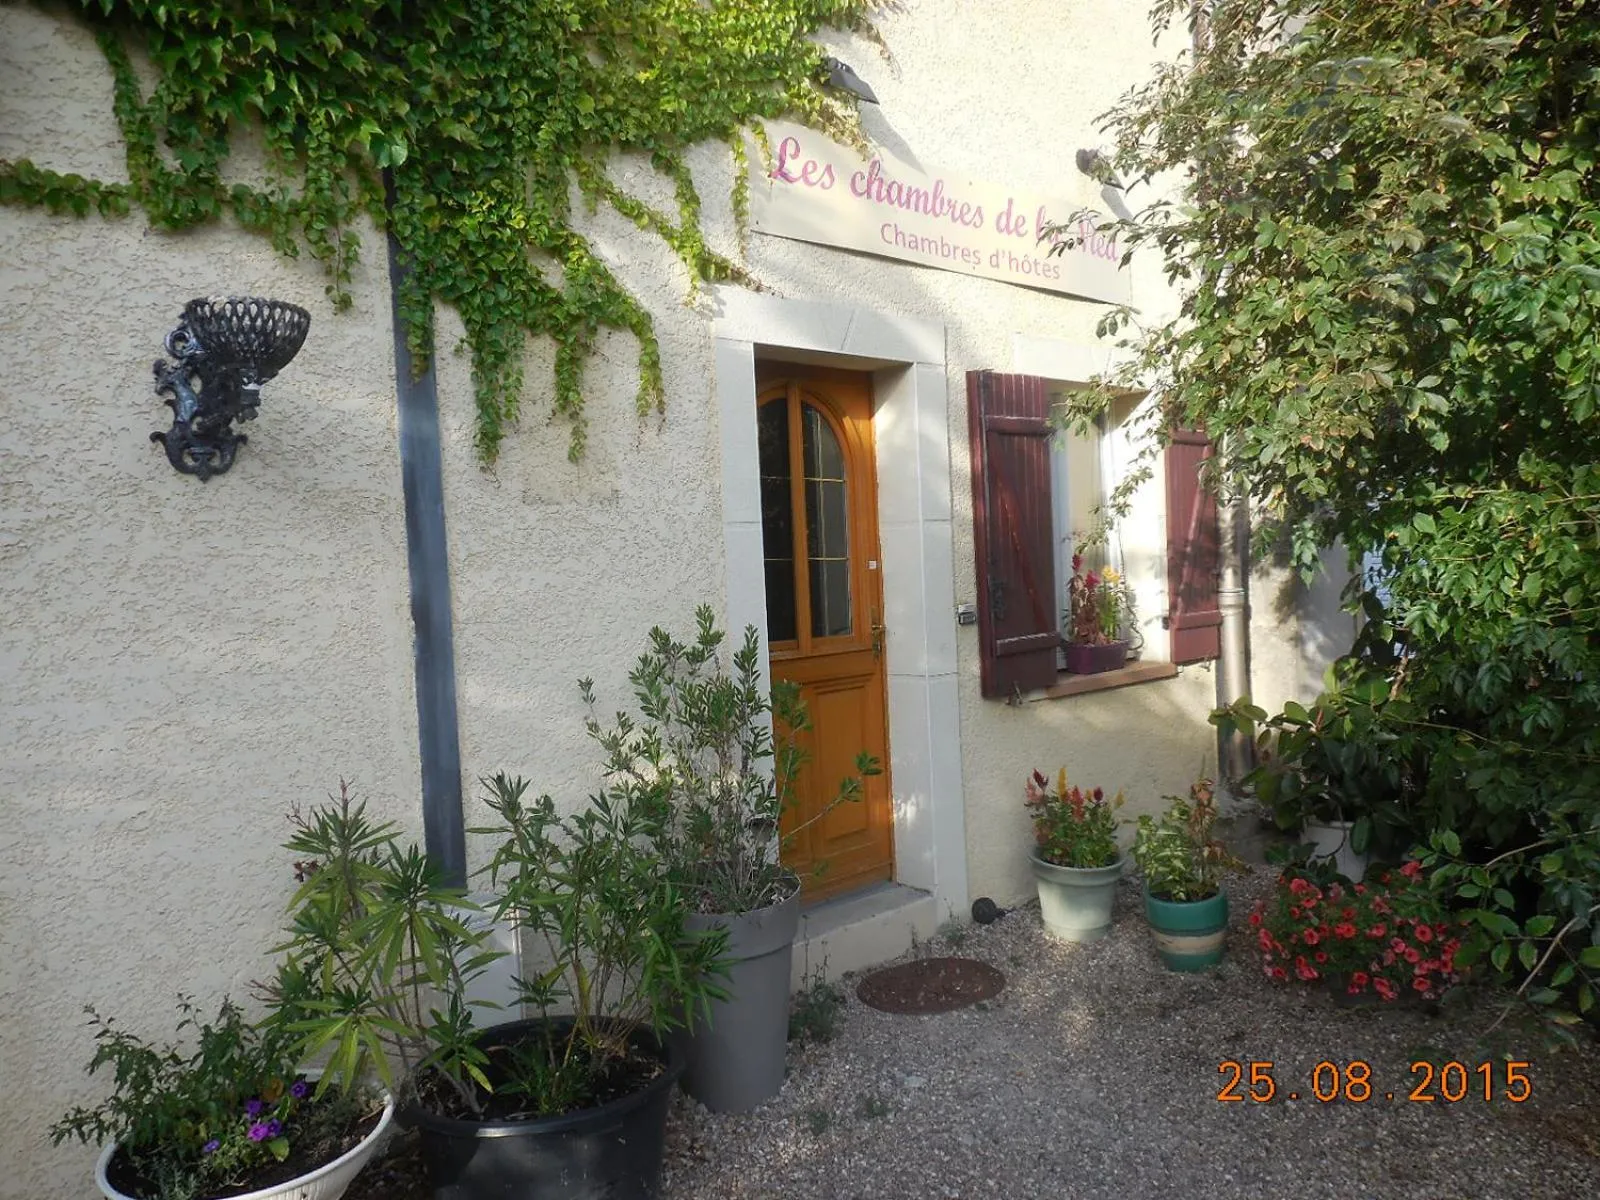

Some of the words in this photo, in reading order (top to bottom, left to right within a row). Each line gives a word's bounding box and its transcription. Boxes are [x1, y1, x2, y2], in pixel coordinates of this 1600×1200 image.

[770, 136, 835, 189] Les
[850, 158, 984, 229] chambres
[995, 198, 1028, 238] de
[880, 223, 982, 265] Chambres
[989, 248, 1061, 280] d'hôtes
